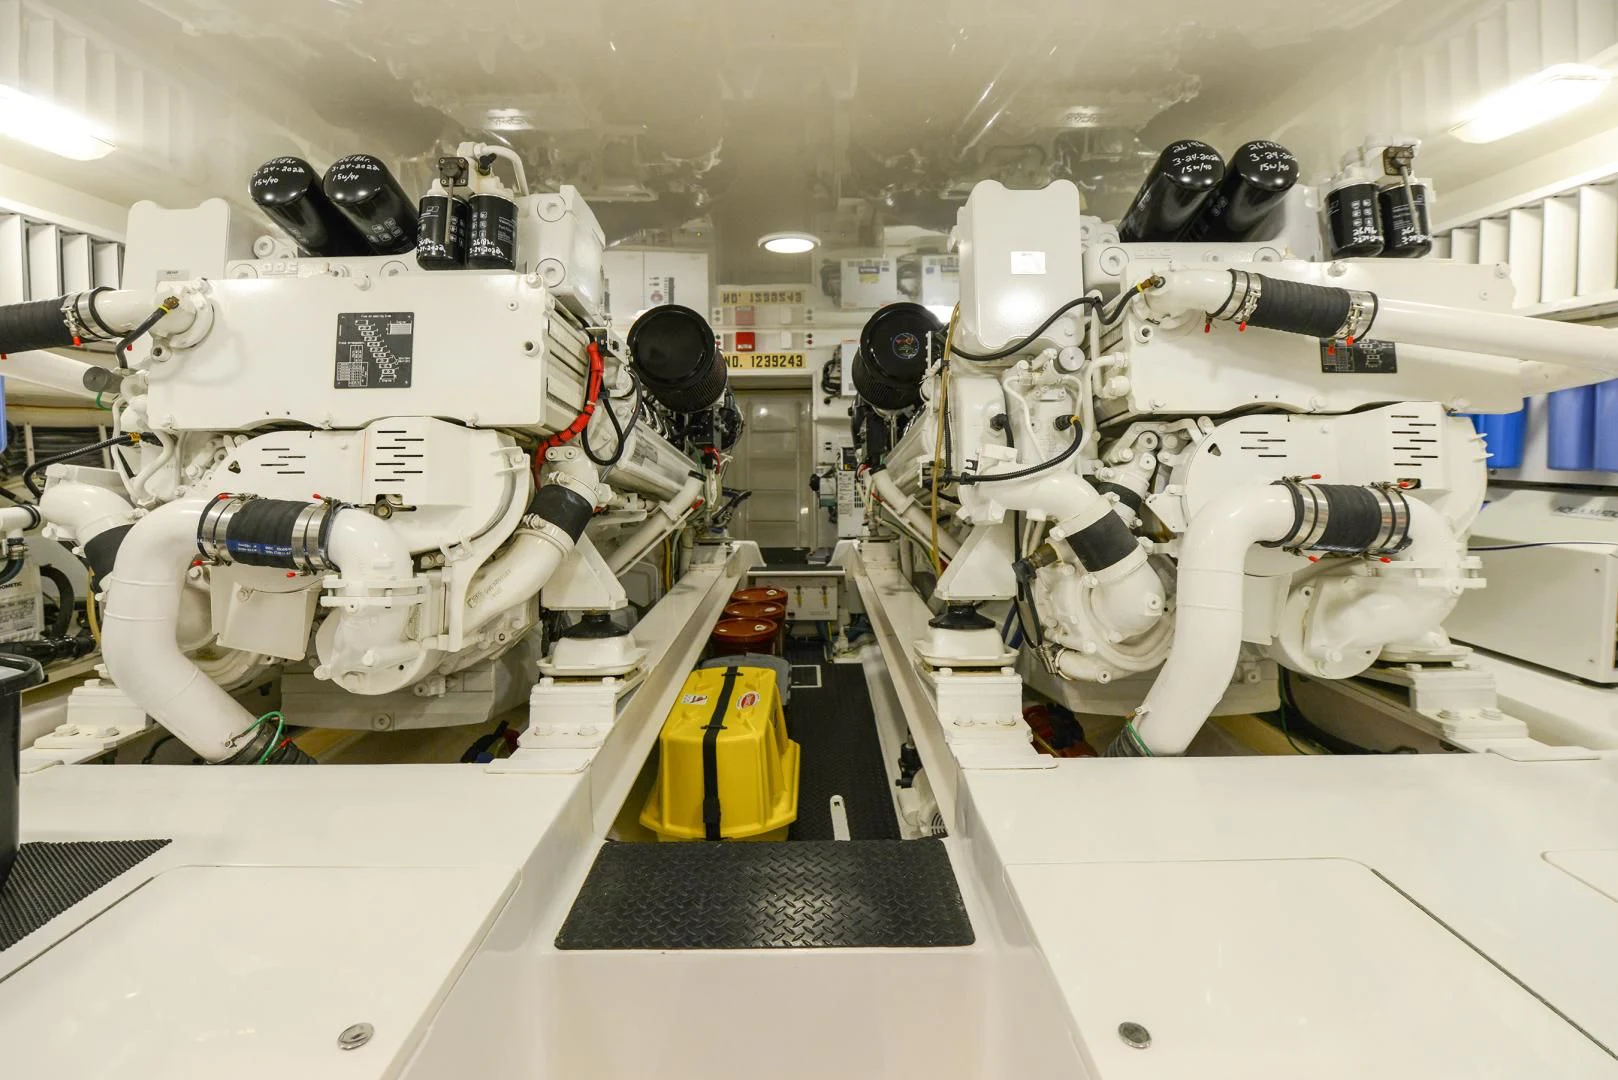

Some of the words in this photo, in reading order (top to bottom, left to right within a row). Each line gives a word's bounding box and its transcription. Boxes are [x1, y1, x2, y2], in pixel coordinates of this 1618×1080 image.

[724, 355, 743, 368] NO.
[751, 355, 803, 368] 1239243
[0, 581, 22, 590] OMETIC
